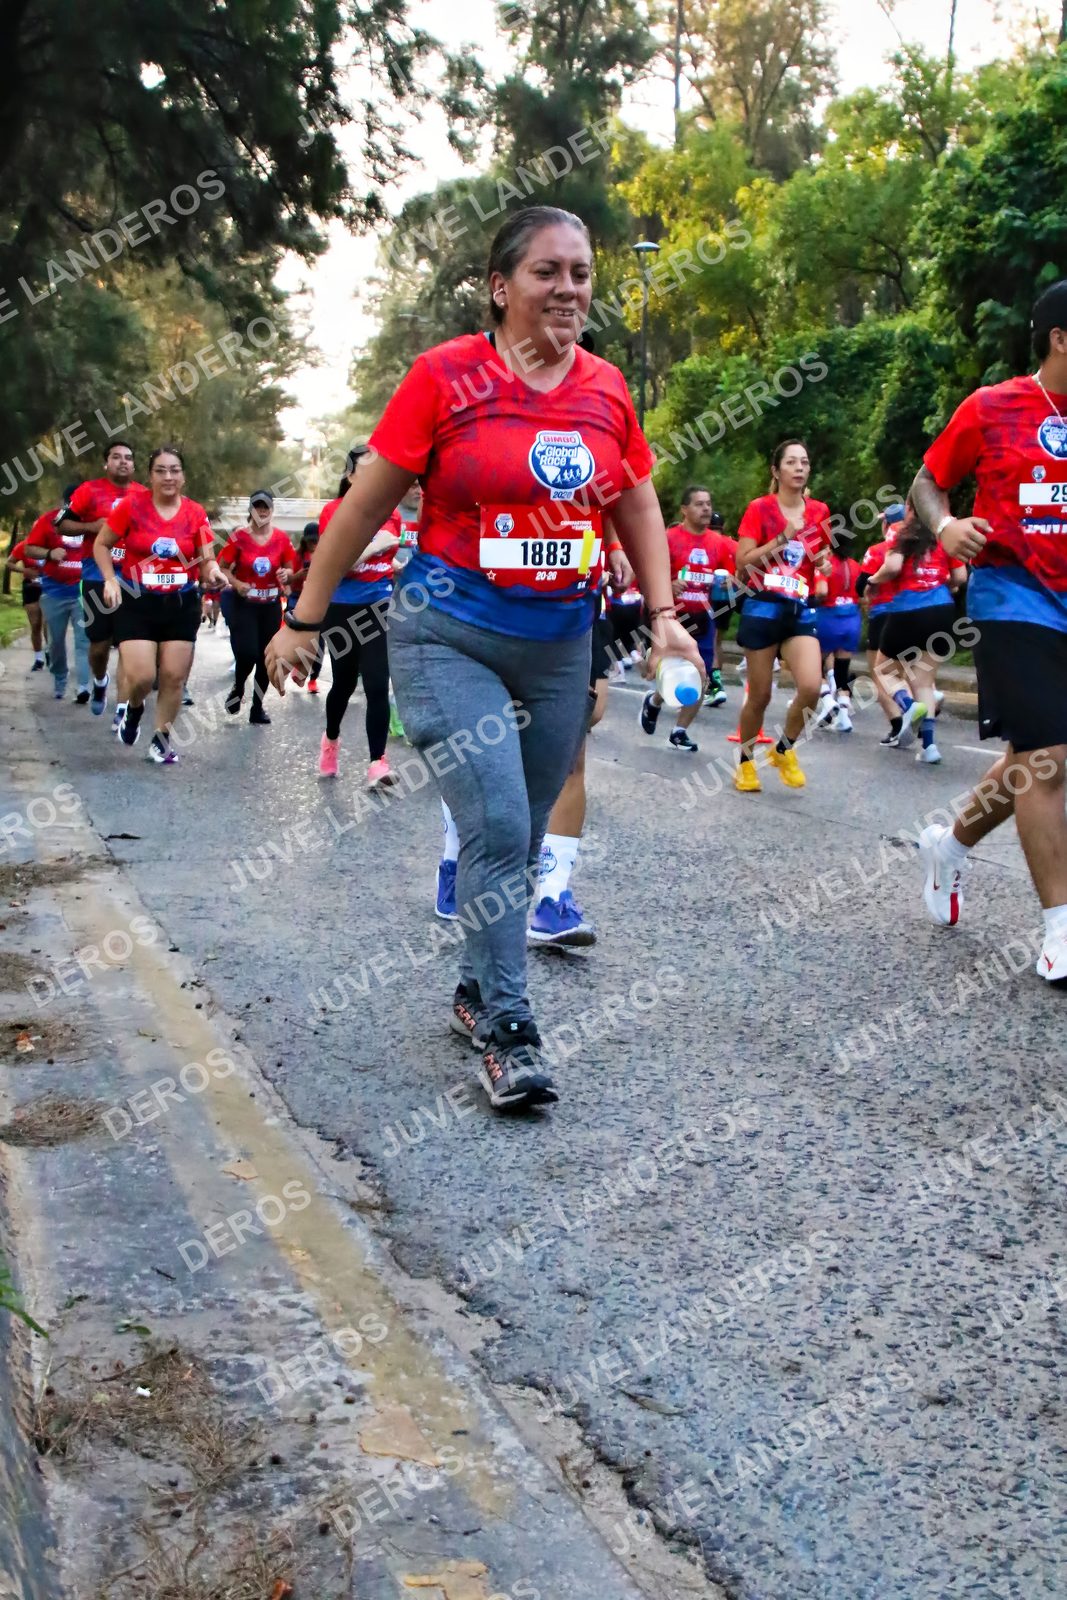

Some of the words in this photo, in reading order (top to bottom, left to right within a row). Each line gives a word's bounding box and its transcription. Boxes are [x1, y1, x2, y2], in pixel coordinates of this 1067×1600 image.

[545, 446, 577, 457] Global
[539, 455, 566, 466] Race
[521, 541, 572, 566] 1883
